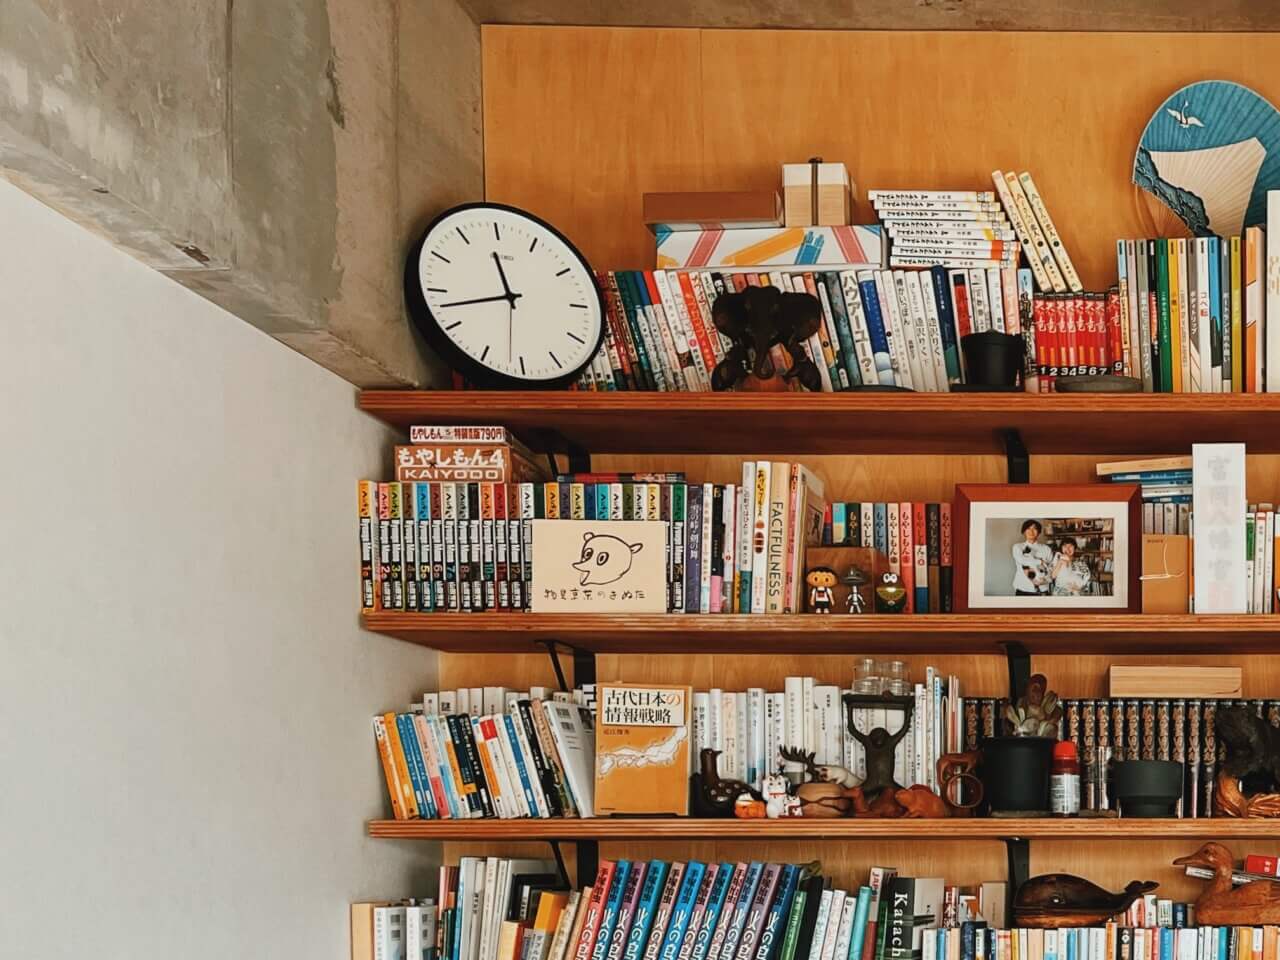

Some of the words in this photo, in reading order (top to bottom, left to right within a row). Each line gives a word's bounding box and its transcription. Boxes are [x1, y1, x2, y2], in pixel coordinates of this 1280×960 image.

[1078, 366, 1087, 375] 5
[1115, 362, 1123, 371] 9
[1050, 367, 1058, 376] 2
[1061, 367, 1069, 376] 3
[1089, 367, 1097, 376] 6
[405, 469, 498, 480] KAIYODO
[769, 502, 784, 597] FACTFULNESS
[607, 689, 681, 707] 古代日本の
[605, 707, 671, 724] 情報戦略
